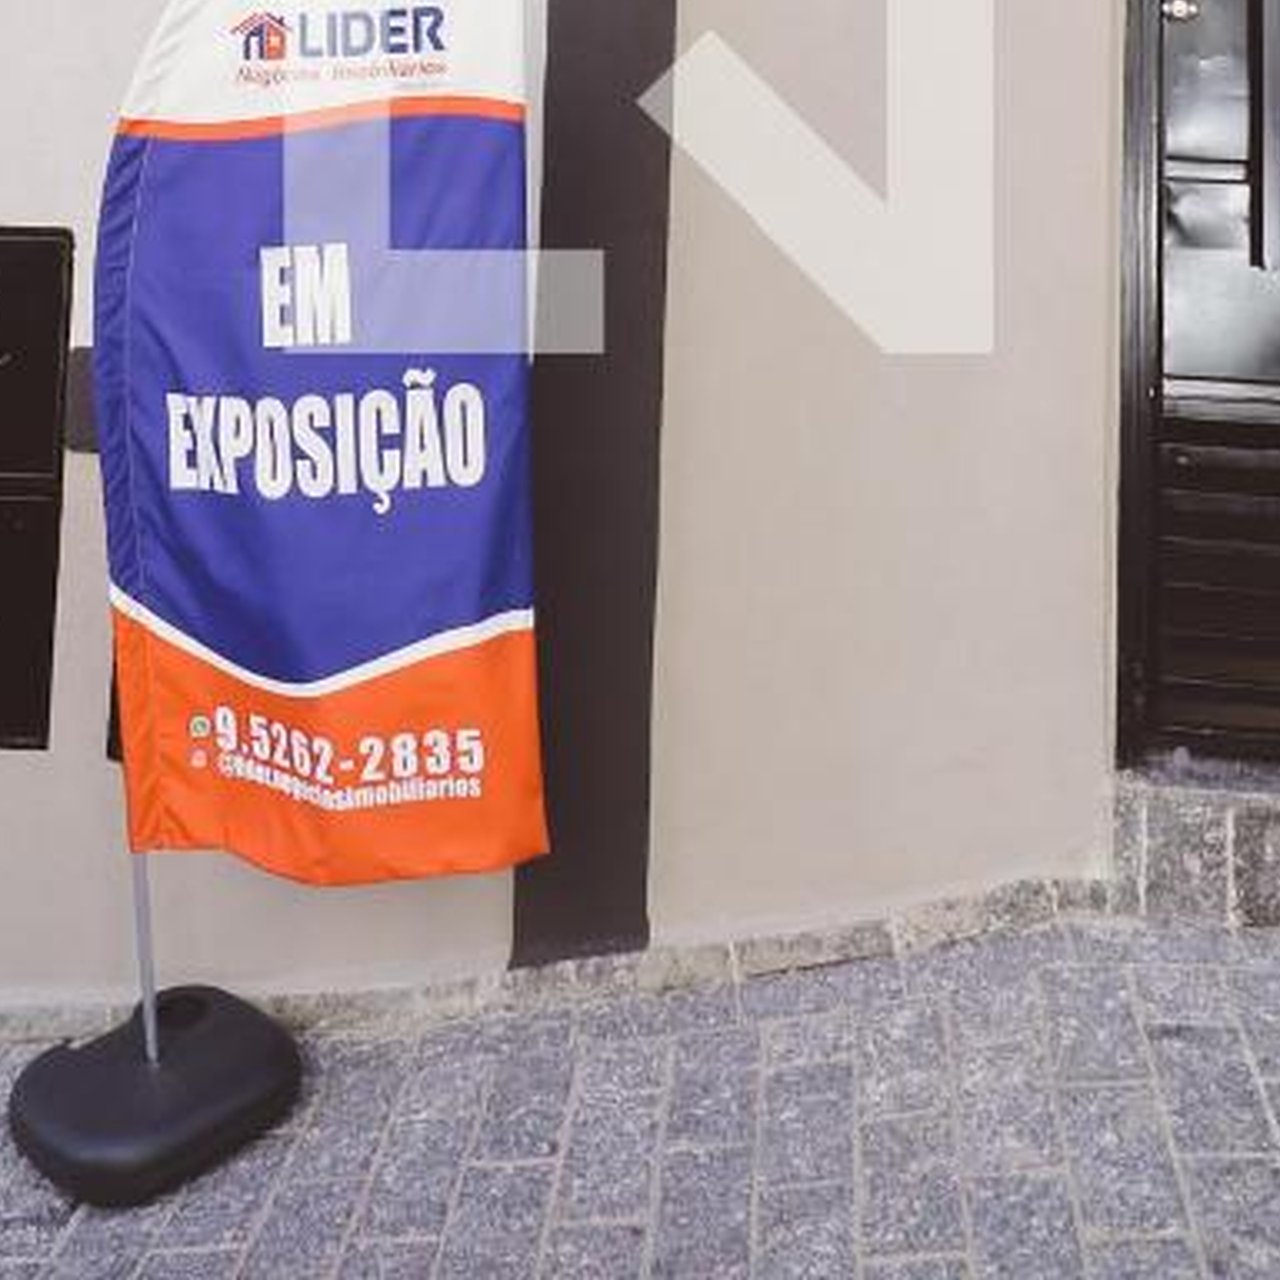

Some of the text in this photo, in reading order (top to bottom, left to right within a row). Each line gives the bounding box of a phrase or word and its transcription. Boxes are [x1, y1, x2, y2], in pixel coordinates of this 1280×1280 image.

[298, 6, 446, 58] LIDER
[260, 242, 351, 349] EM
[166, 368, 486, 514] EXPOSIÇÃO
[214, 706, 485, 785] 9.5262-2835
